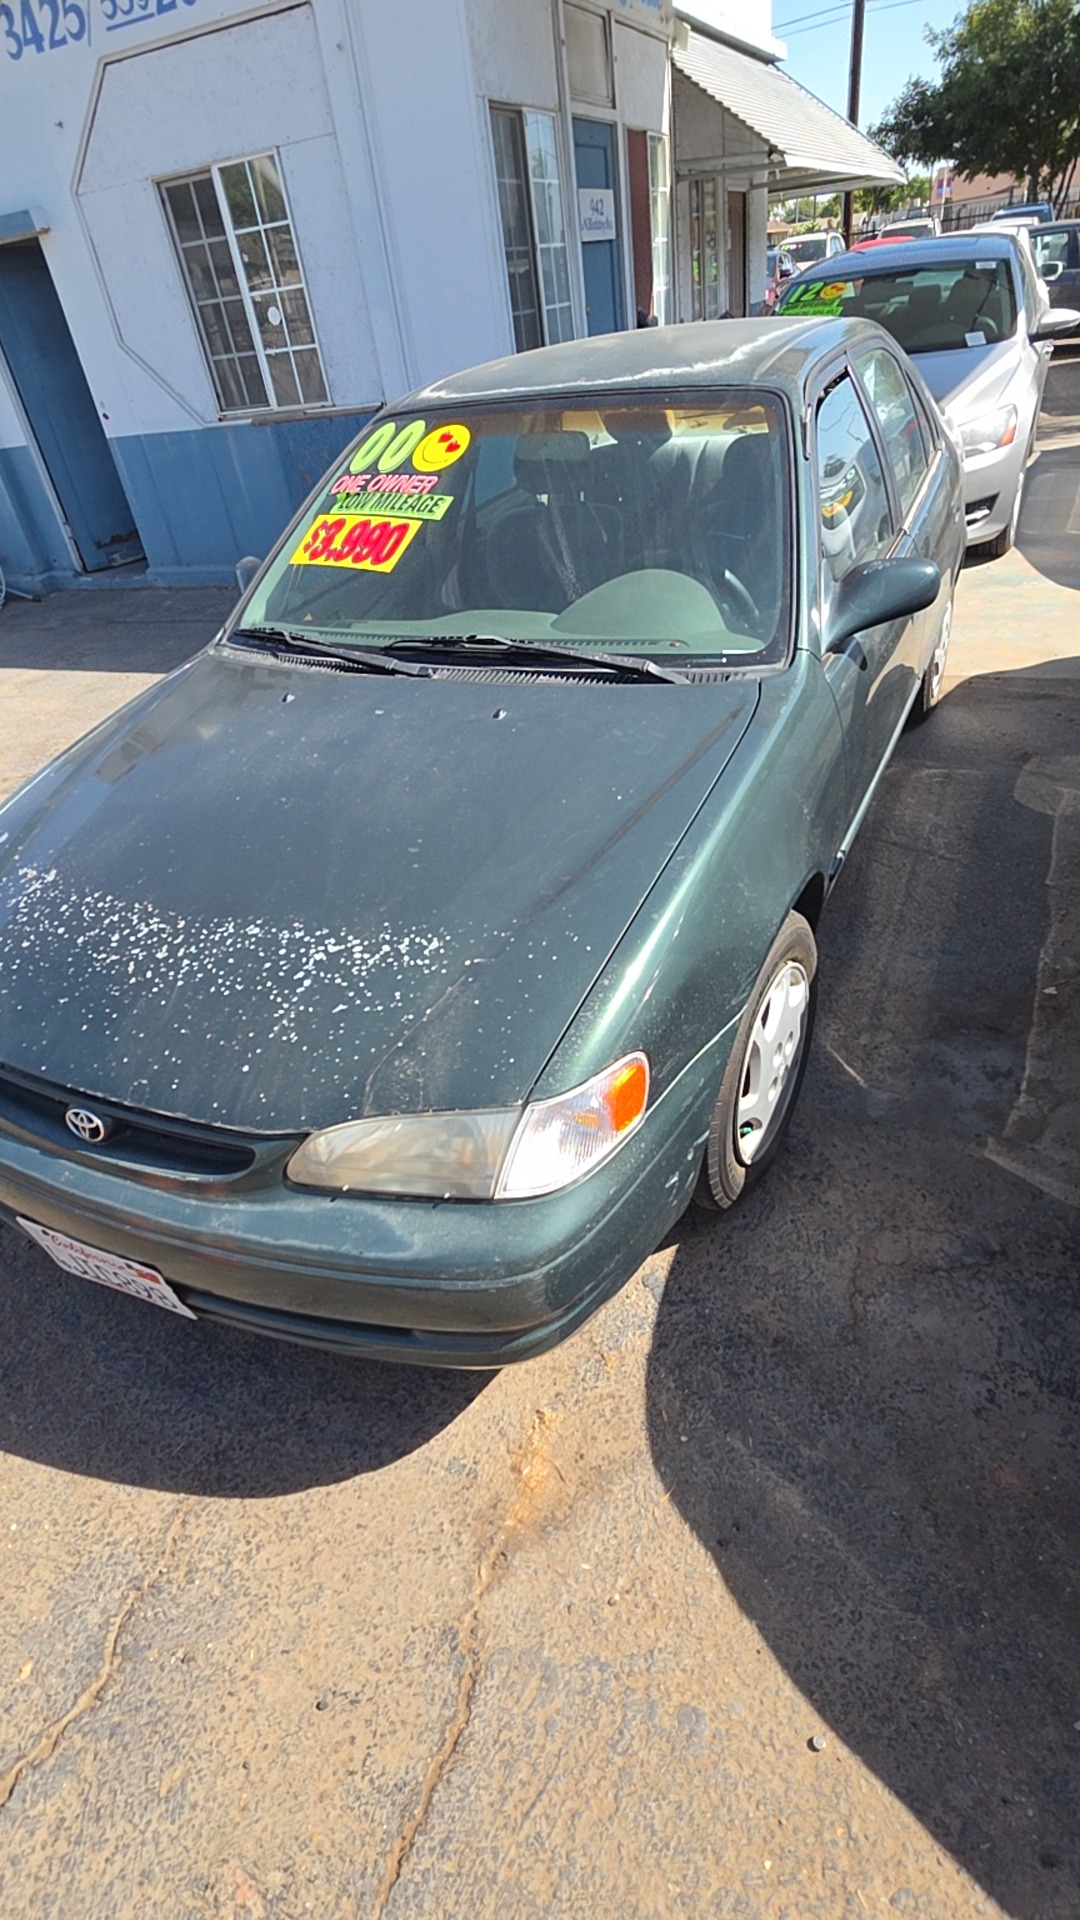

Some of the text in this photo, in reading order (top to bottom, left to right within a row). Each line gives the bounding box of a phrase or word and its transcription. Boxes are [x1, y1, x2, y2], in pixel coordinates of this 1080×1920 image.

[0, 0, 86, 60] 3425
[589, 198, 604, 216] 942
[789, 281, 824, 303] 12
[350, 420, 426, 474] 00
[330, 474, 439, 495] ONE OWNER
[337, 492, 444, 515] LOW MILEAGE
